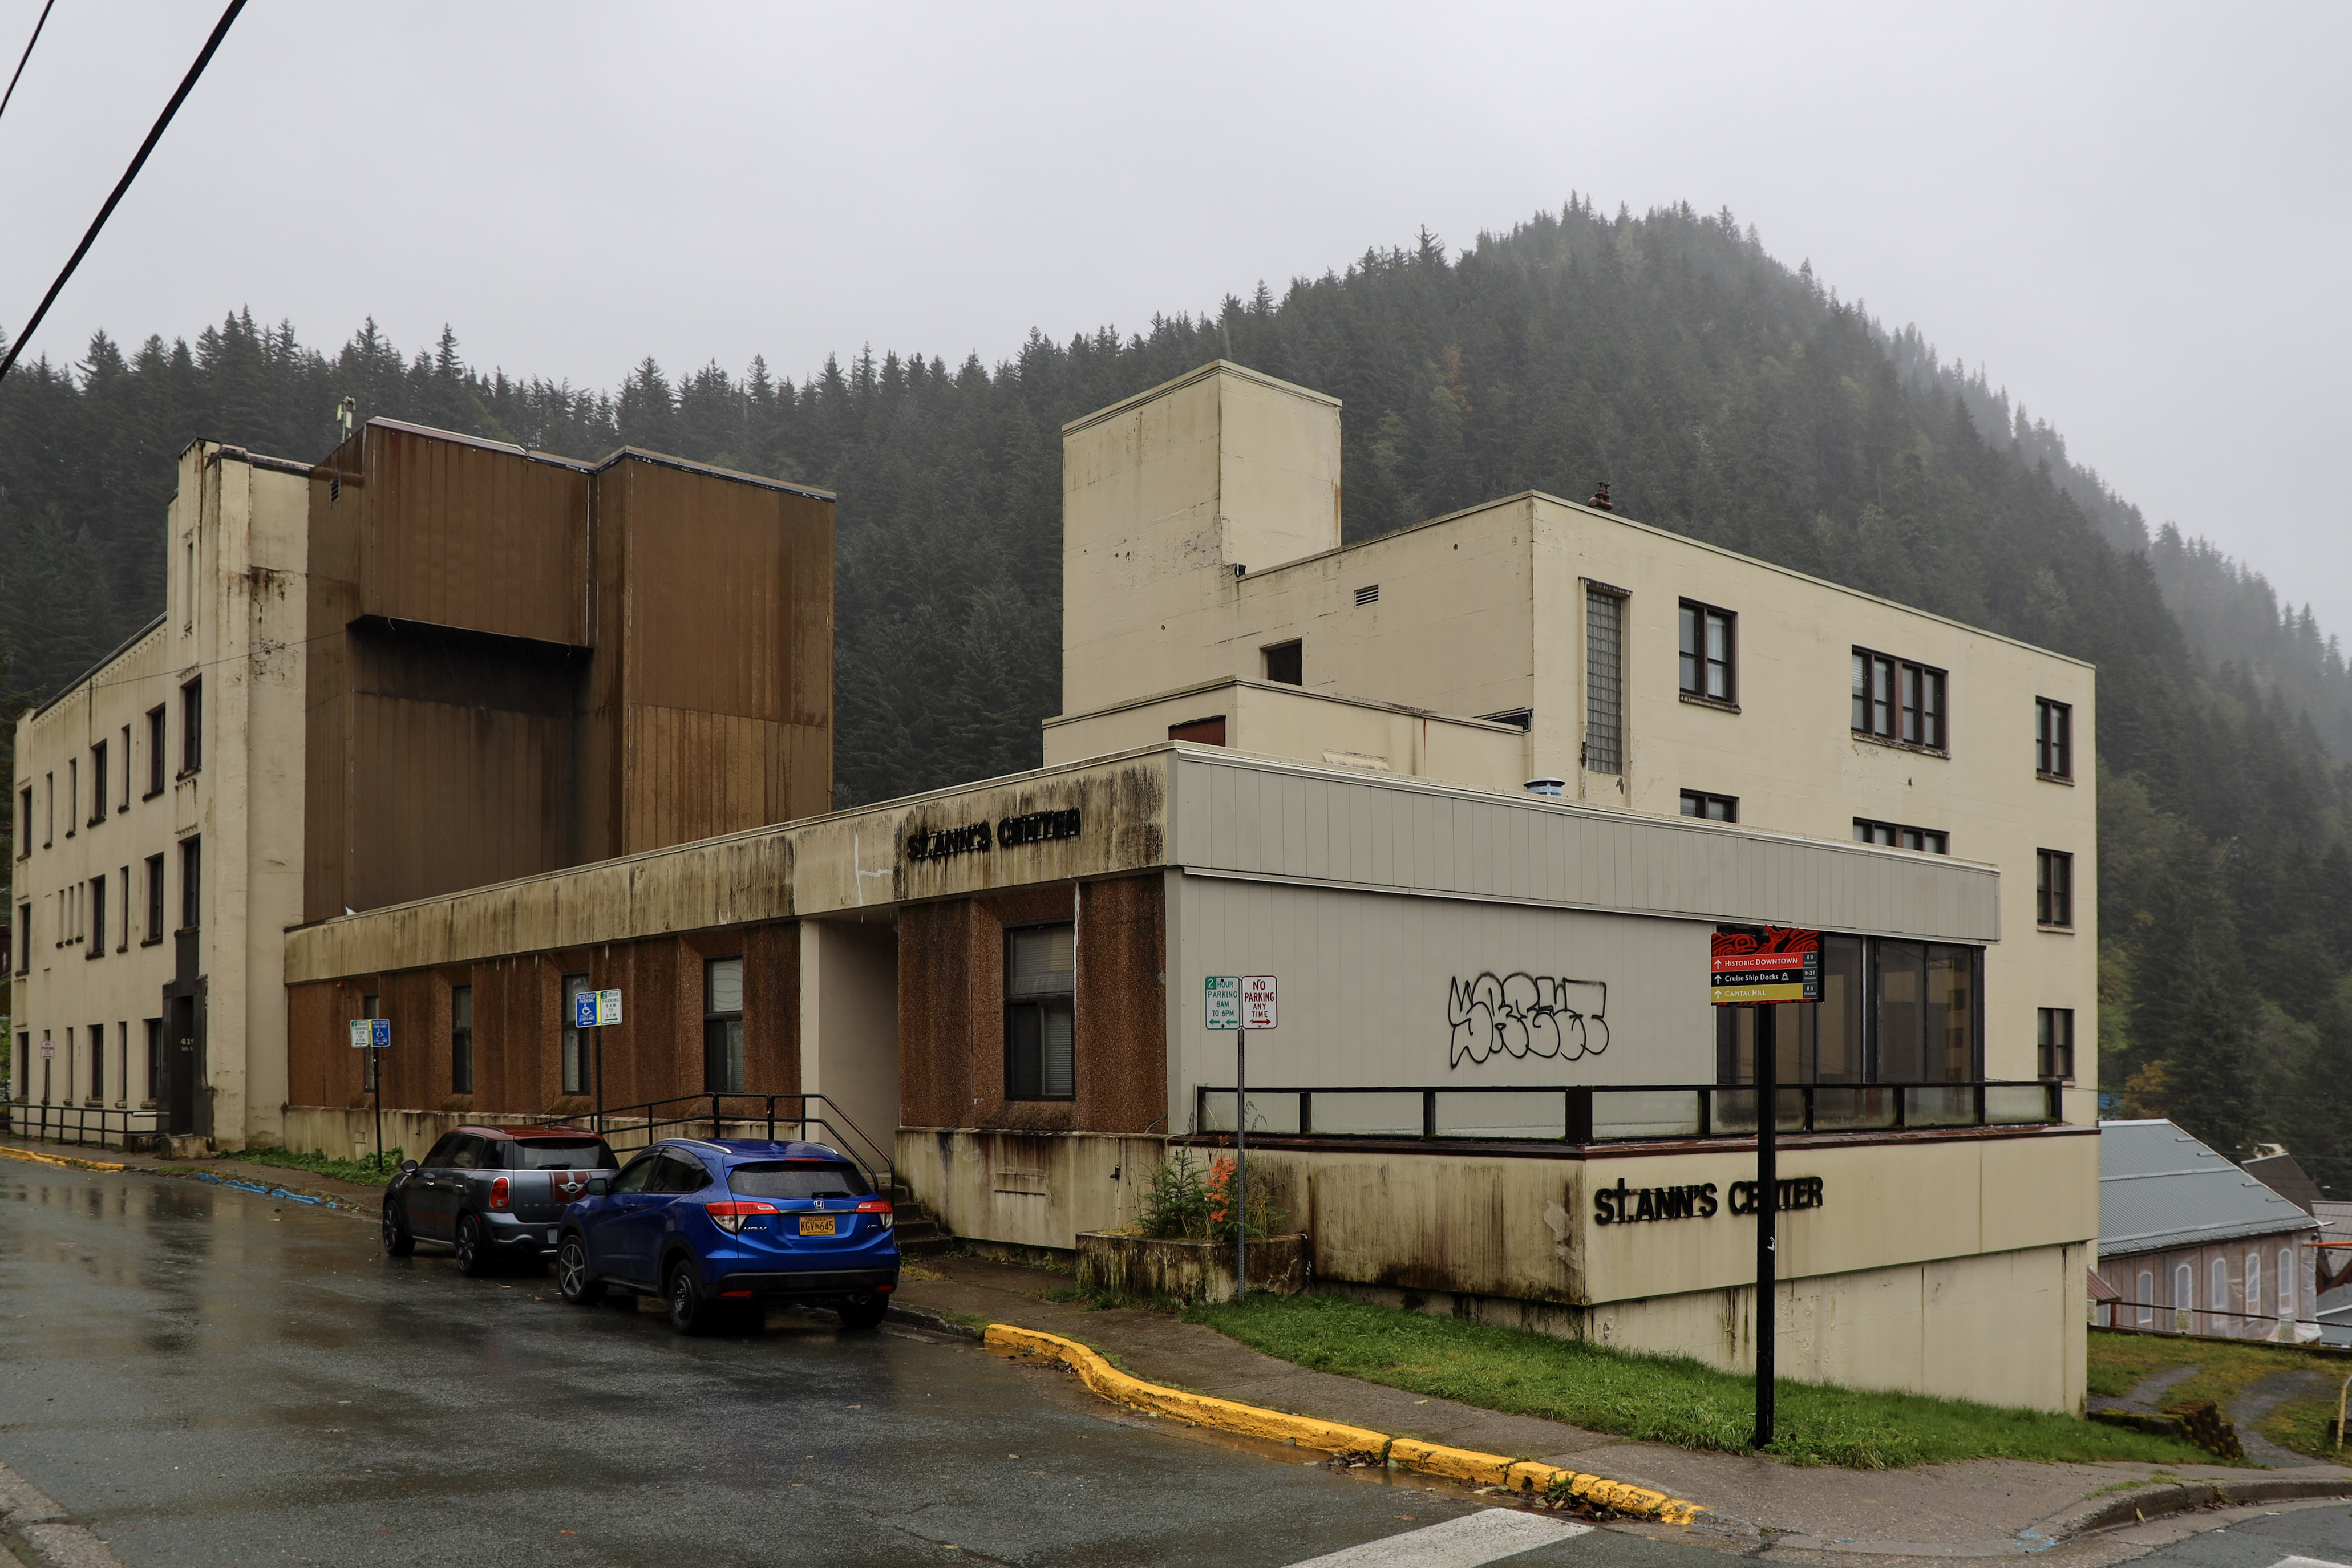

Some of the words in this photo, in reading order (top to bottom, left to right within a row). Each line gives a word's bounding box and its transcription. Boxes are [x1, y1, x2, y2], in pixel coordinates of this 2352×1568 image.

[997, 808, 1080, 846] CENTER
[1208, 978, 1214, 988] 2
[1253, 981, 1266, 991] NO
[1244, 992, 1274, 1002] PARKING
[1636, 1182, 1718, 1221] ANN'S
[1728, 1177, 1824, 1215] CETER
[800, 1221, 815, 1231] KGV
[820, 1221, 833, 1231] 645
